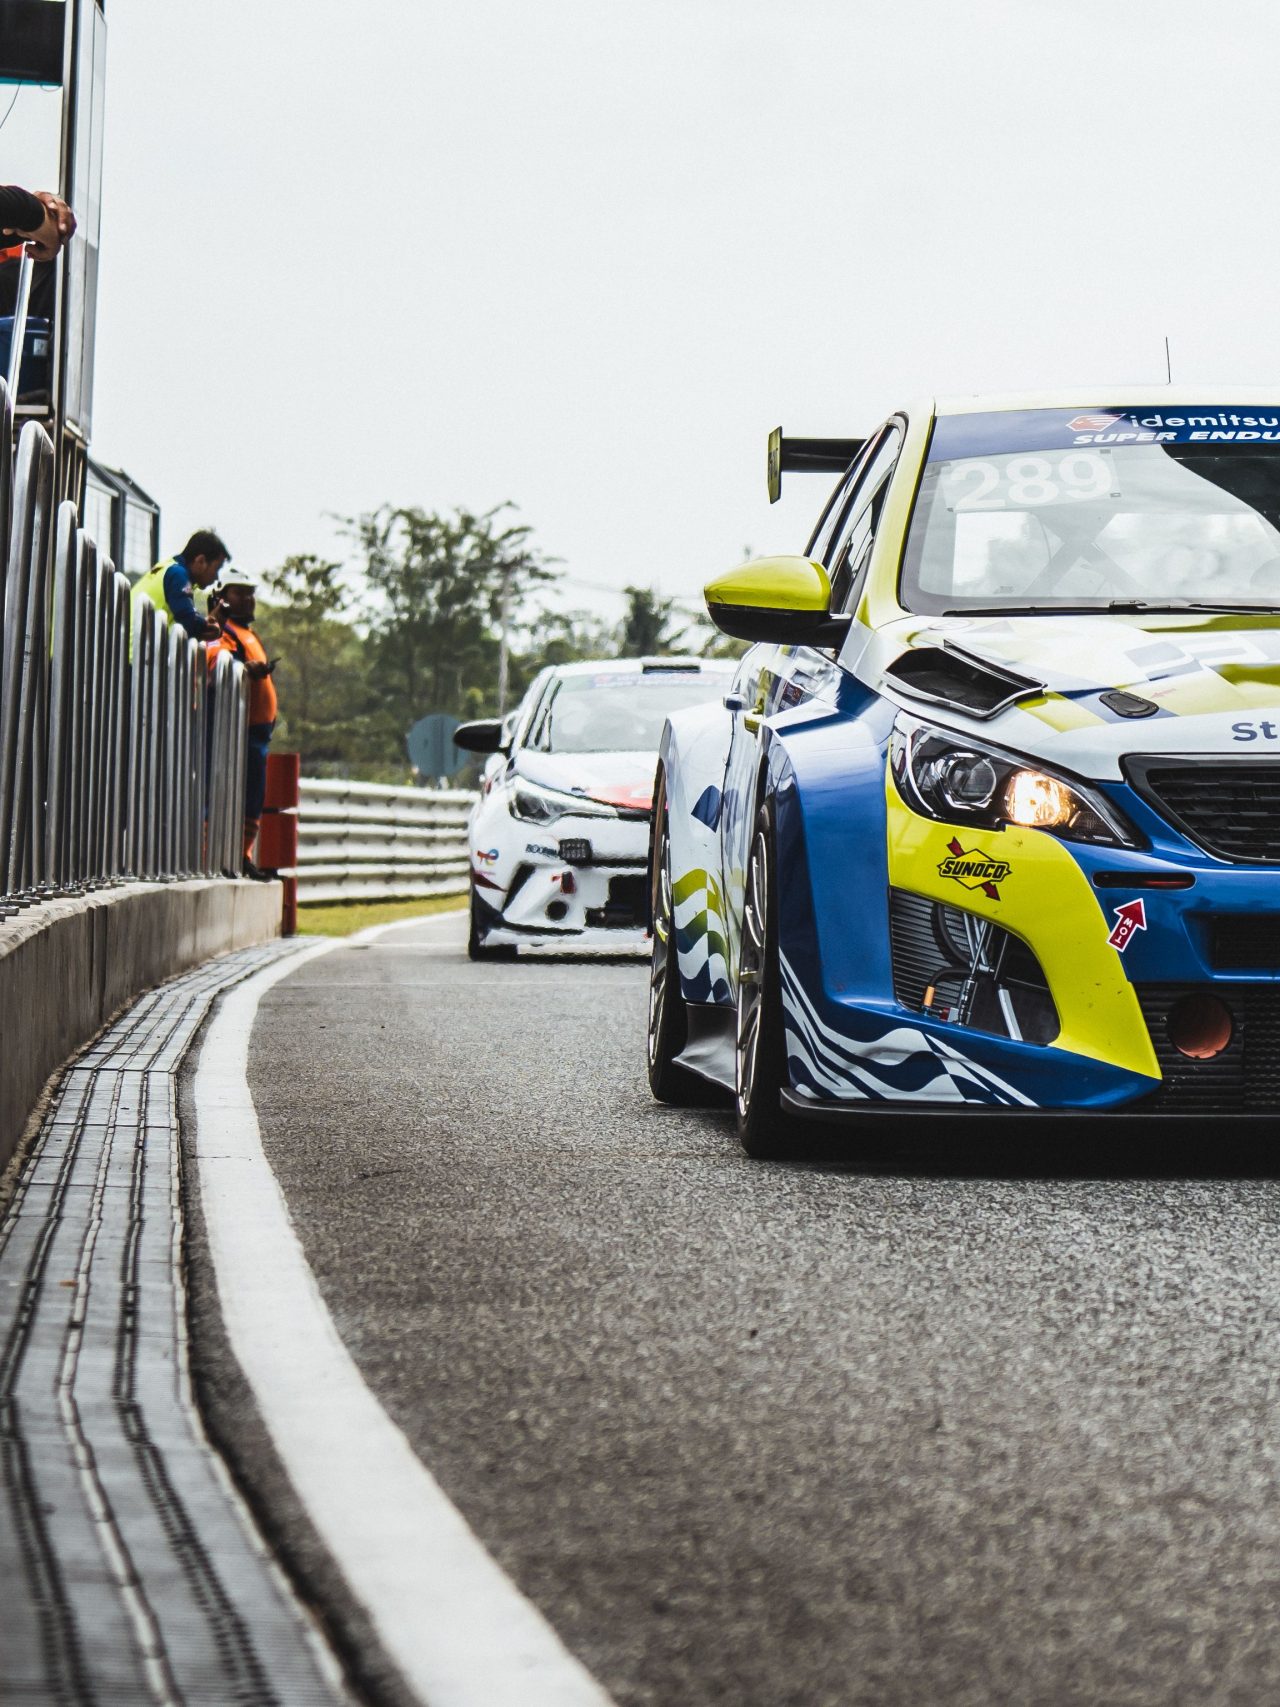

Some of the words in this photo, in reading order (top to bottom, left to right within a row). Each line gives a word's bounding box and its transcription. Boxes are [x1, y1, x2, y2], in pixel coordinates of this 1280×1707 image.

[1131, 413, 1279, 430] idemitsu
[1072, 431, 1178, 445] SUPER
[950, 453, 1115, 509] 289
[941, 859, 1005, 880] SUNOCO
[1114, 917, 1134, 945] TOW
